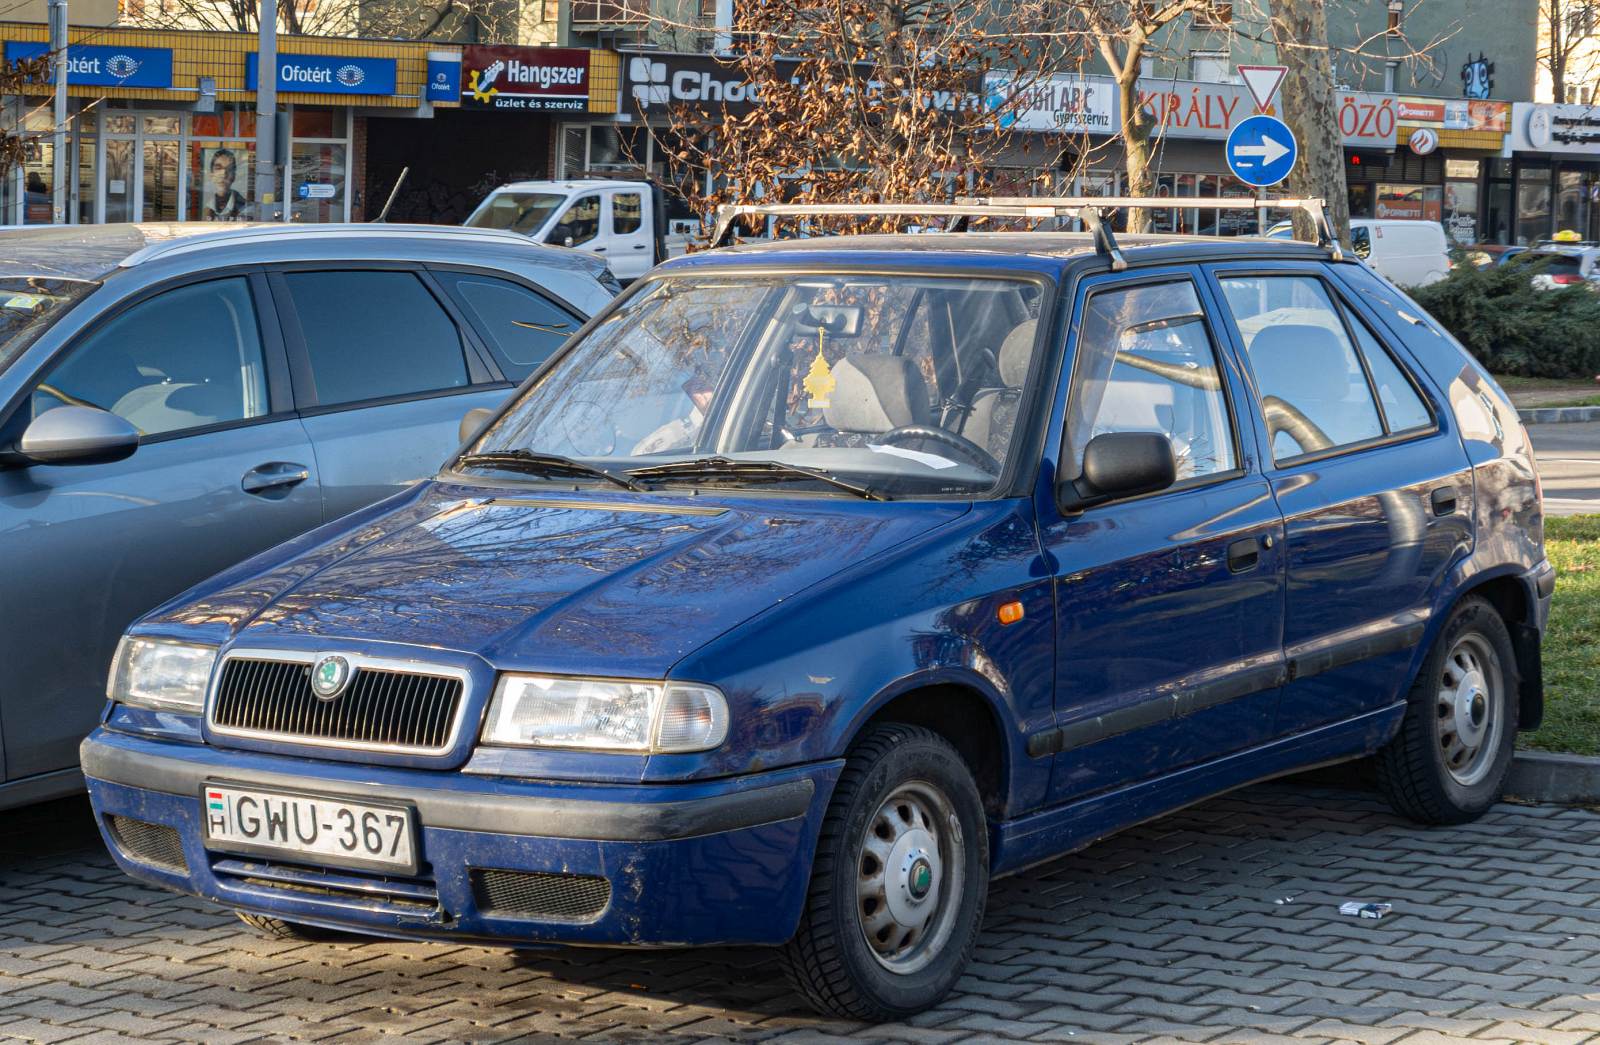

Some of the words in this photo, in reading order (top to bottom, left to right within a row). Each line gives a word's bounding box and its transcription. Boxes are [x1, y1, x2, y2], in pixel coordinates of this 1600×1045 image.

[65, 56, 101, 74] otért
[281, 65, 332, 83] Ofotért
[507, 60, 585, 89] Hangszer
[495, 99, 526, 108] üzlet
[529, 100, 542, 109] és
[544, 100, 584, 110] szerviz
[1059, 86, 1093, 113] ABC
[1137, 87, 1241, 130] KIRÁLY
[1338, 96, 1395, 138] ÖZŐ
[209, 814, 226, 835] H
[236, 795, 405, 858] GWU-367
